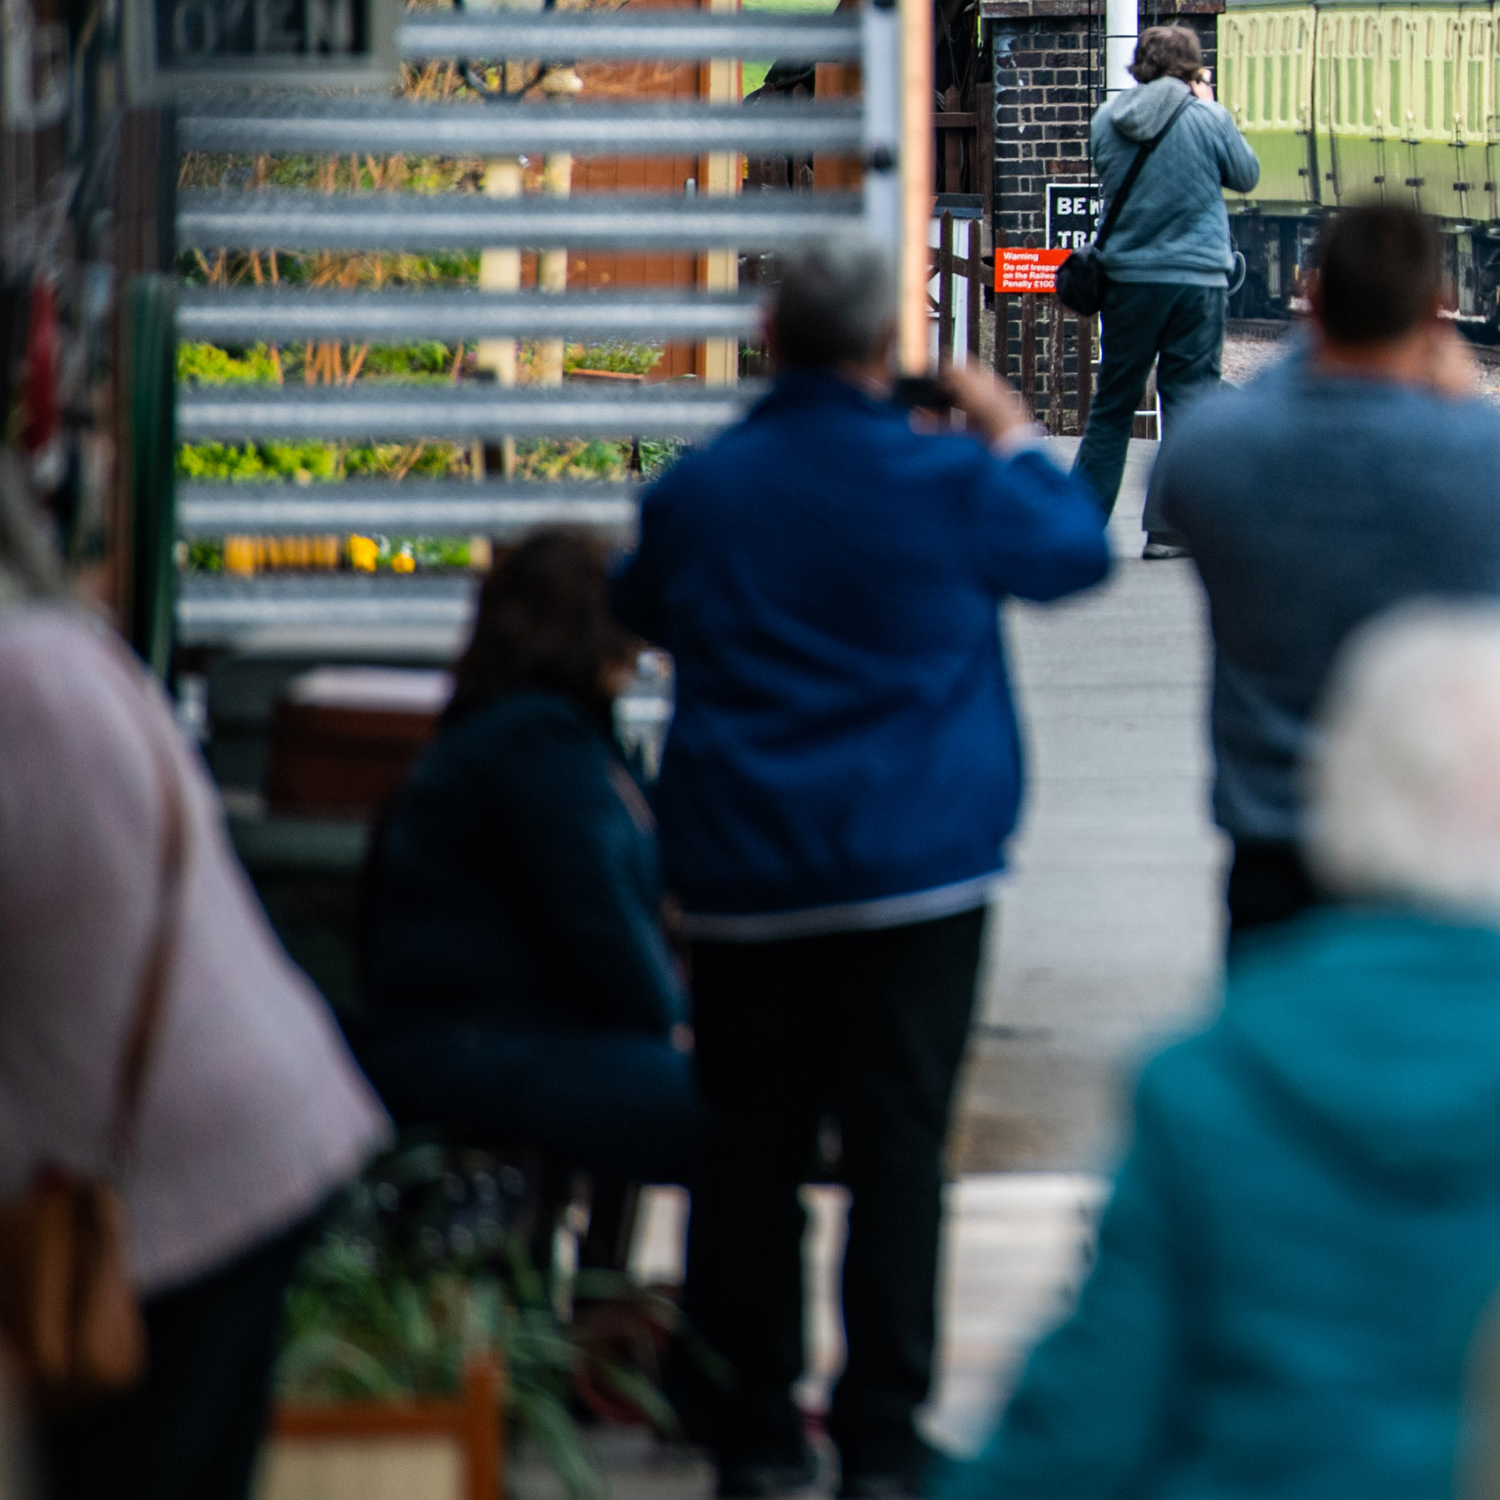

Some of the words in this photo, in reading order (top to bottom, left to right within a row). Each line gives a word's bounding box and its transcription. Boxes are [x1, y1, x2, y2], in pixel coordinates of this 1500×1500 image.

[1057, 197, 1104, 215] BEW
[1003, 252, 1039, 262] Warning
[1003, 263, 1014, 271] Do
[1029, 271, 1055, 279] Railwa
[1003, 280, 1033, 289] Penalty
[1034, 281, 1055, 289] £100
